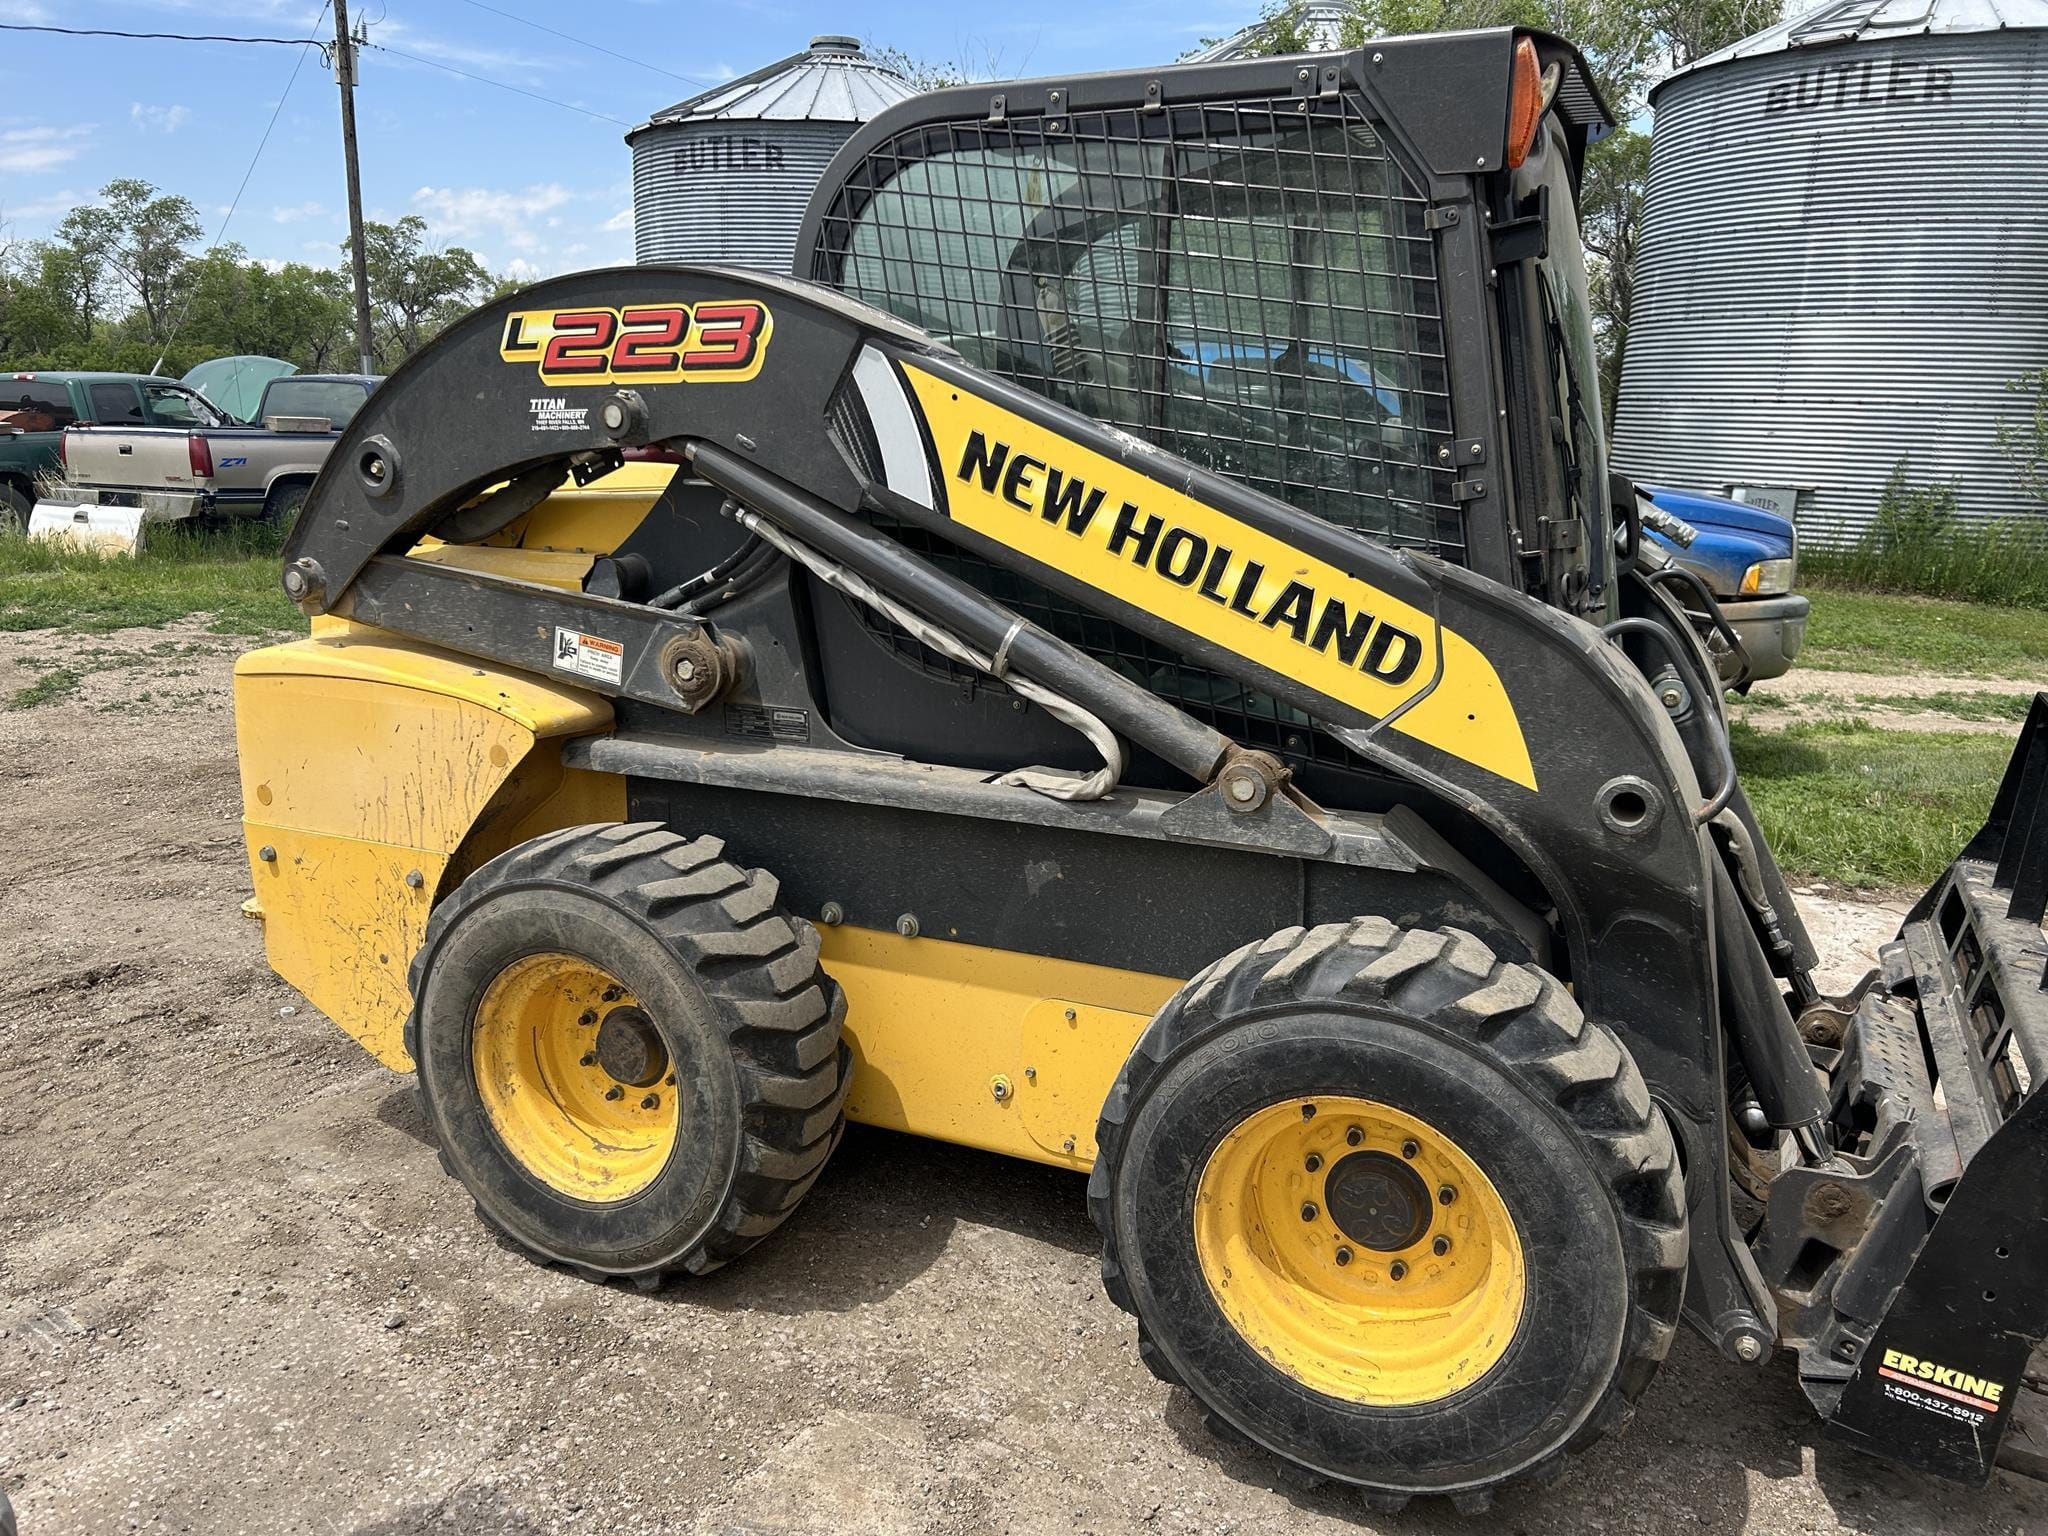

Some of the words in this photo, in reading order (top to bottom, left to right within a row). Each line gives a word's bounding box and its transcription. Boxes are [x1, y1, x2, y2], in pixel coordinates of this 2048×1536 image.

[1764, 57, 1954, 114] BUTLER
[674, 135, 784, 174] BUTLER
[504, 304, 769, 377] L223
[529, 398, 566, 410] TITAN
[538, 411, 587, 420] MACHINERY
[956, 429, 1107, 538] NEW
[1106, 500, 1423, 686] HOLLAND
[589, 640, 619, 653] WARNING
[1158, 1022, 1280, 1104] XD2010
[1882, 1348, 2004, 1403] ERSKINE
[1884, 1383, 1985, 1423] 1-800-437-6912
